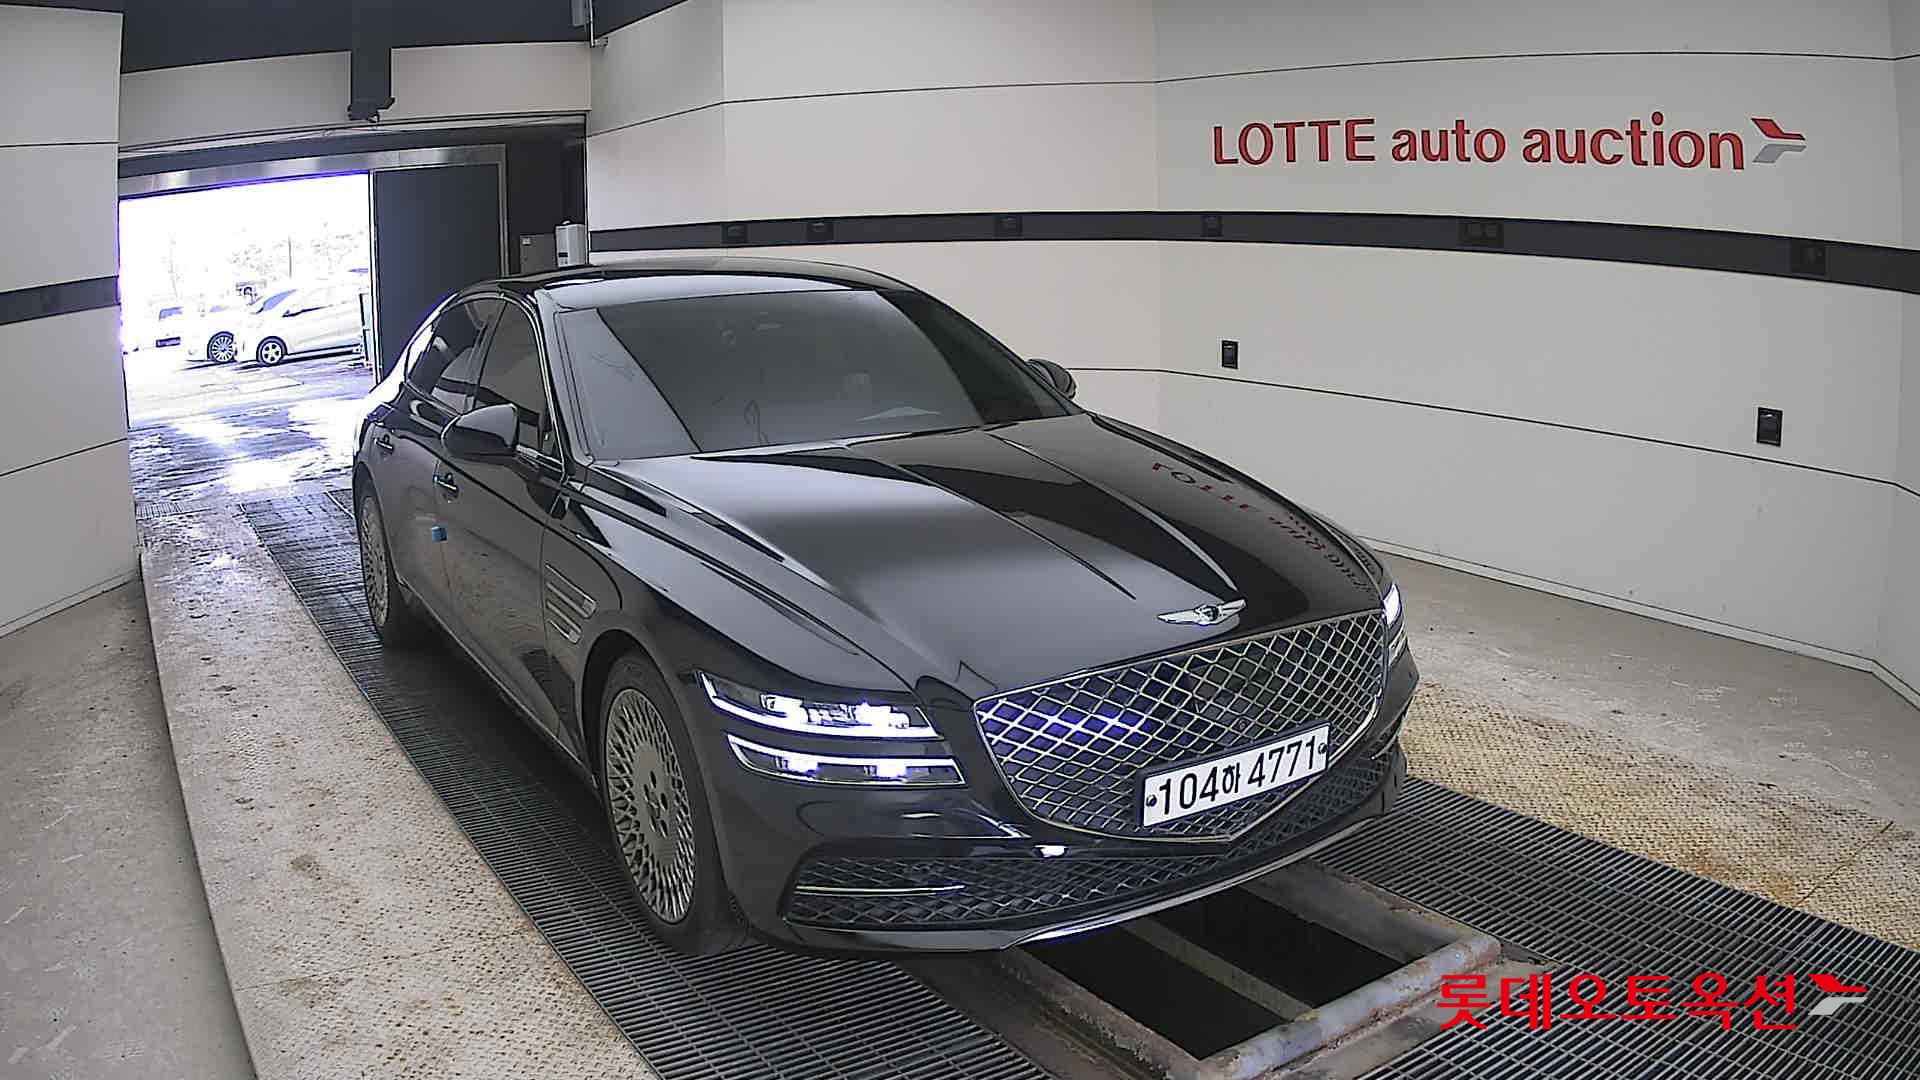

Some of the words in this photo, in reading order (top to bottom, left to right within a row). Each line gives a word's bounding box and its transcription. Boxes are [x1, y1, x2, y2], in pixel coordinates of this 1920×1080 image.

[1213, 117, 1376, 165] LOTTE
[1391, 119, 1506, 164] auto
[1522, 111, 1744, 171] auction
[1159, 762, 1242, 815] 104하
[1248, 735, 1316, 787] 4771
